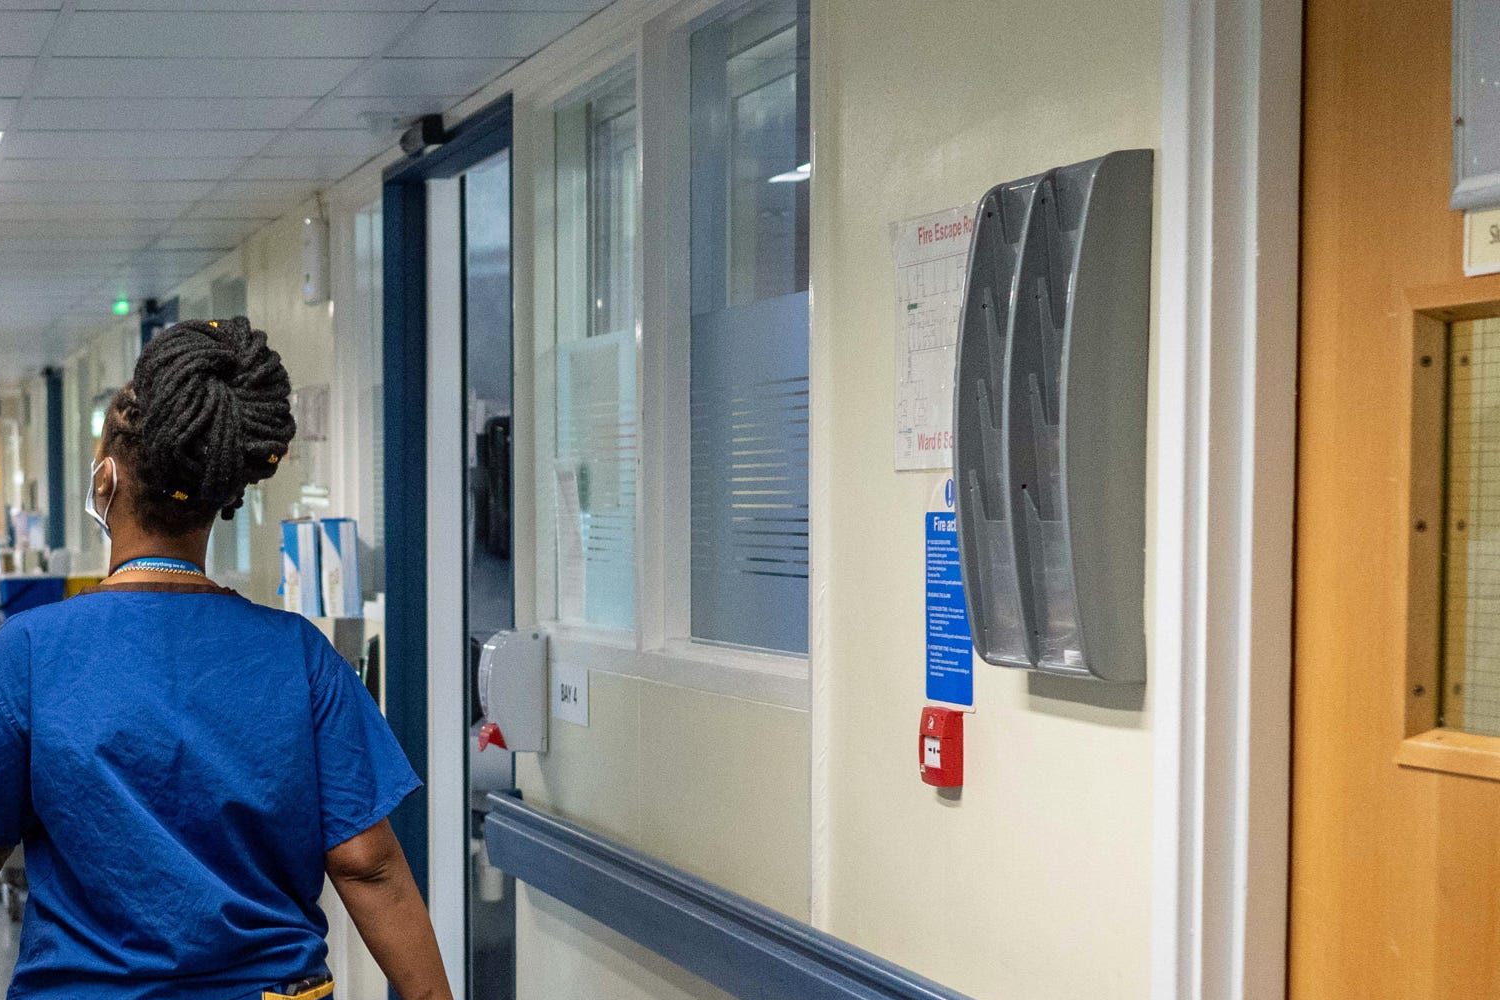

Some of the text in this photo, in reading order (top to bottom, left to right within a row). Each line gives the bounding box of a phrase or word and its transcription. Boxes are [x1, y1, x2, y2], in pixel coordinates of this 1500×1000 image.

[917, 226, 933, 245] Fire
[934, 222, 962, 241] Escape
[917, 432, 936, 450] Ward
[933, 516, 946, 532] Fire
[561, 683, 572, 704] BAY
